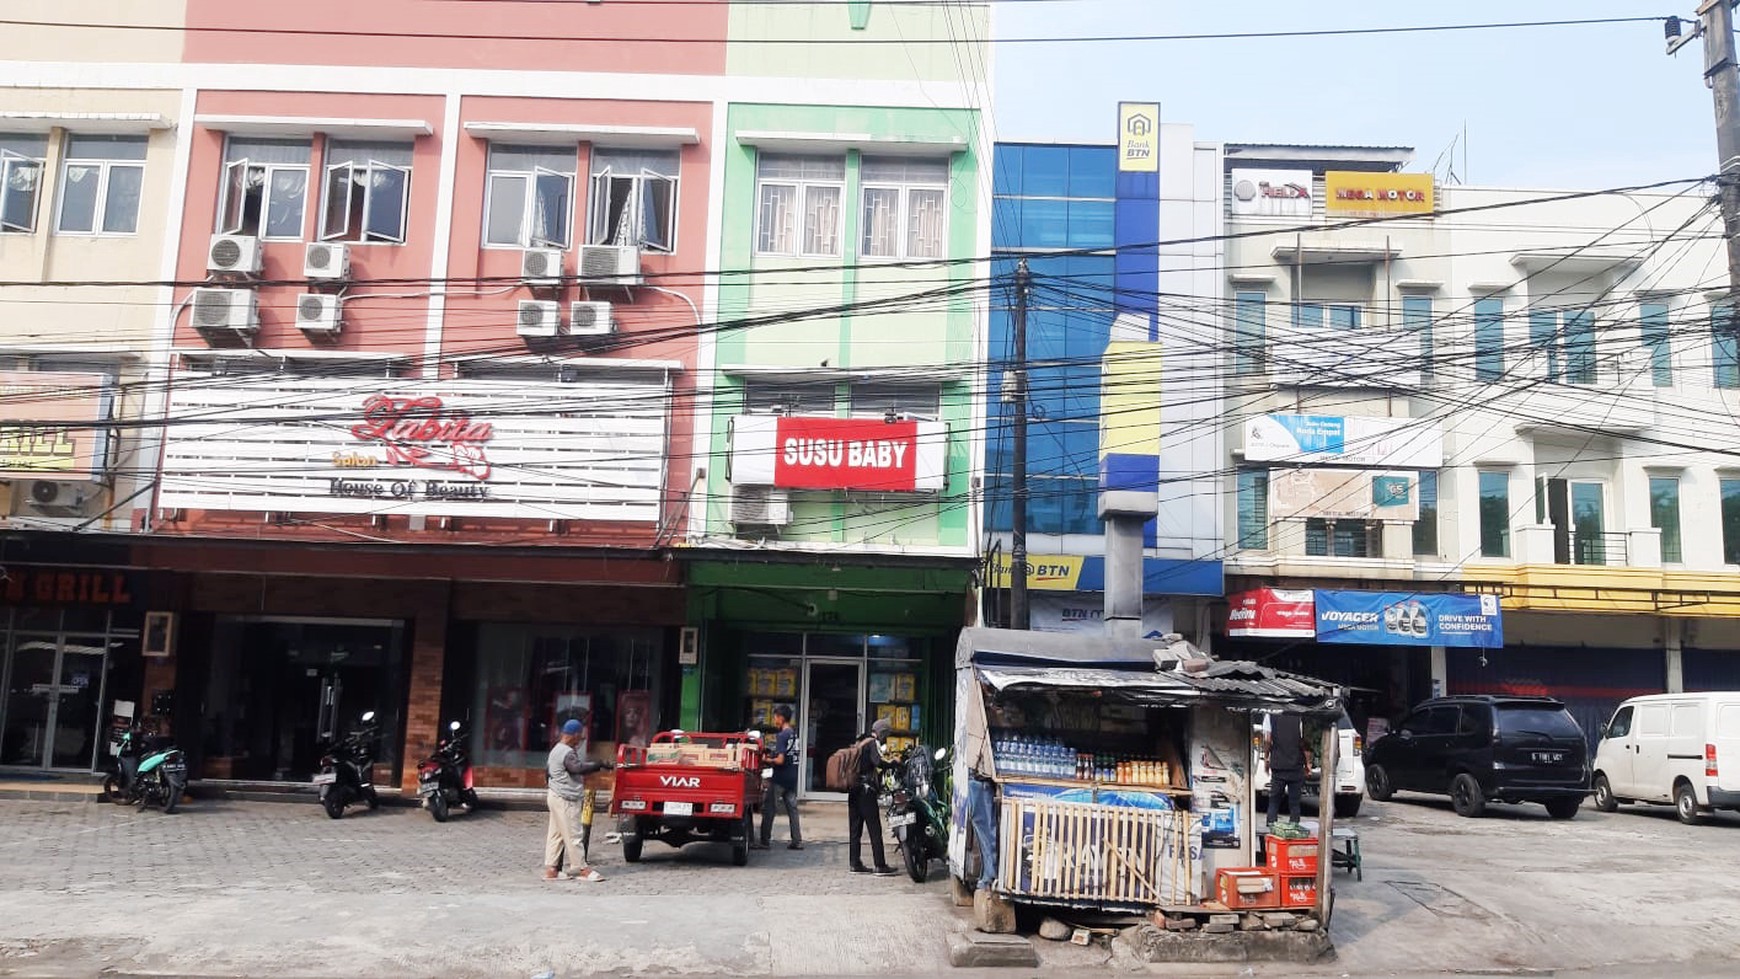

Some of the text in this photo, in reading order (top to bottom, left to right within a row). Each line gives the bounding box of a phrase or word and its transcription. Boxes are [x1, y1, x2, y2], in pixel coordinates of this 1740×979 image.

[1127, 140, 1150, 149] Bank
[1127, 148, 1150, 157] BTN
[1377, 189, 1425, 202] MOTOR
[784, 438, 909, 468] SUSU BABY
[329, 480, 489, 499] House Of Beauty
[1037, 564, 1069, 576] BTN
[36, 572, 132, 603] GRILL
[1062, 608, 1088, 618] BTN
[1321, 610, 1380, 622] VOYAGER
[1438, 614, 1487, 623] DRIVE WITH
[1438, 622, 1493, 632] CONFIDENCE
[660, 775, 701, 788] VIAR
